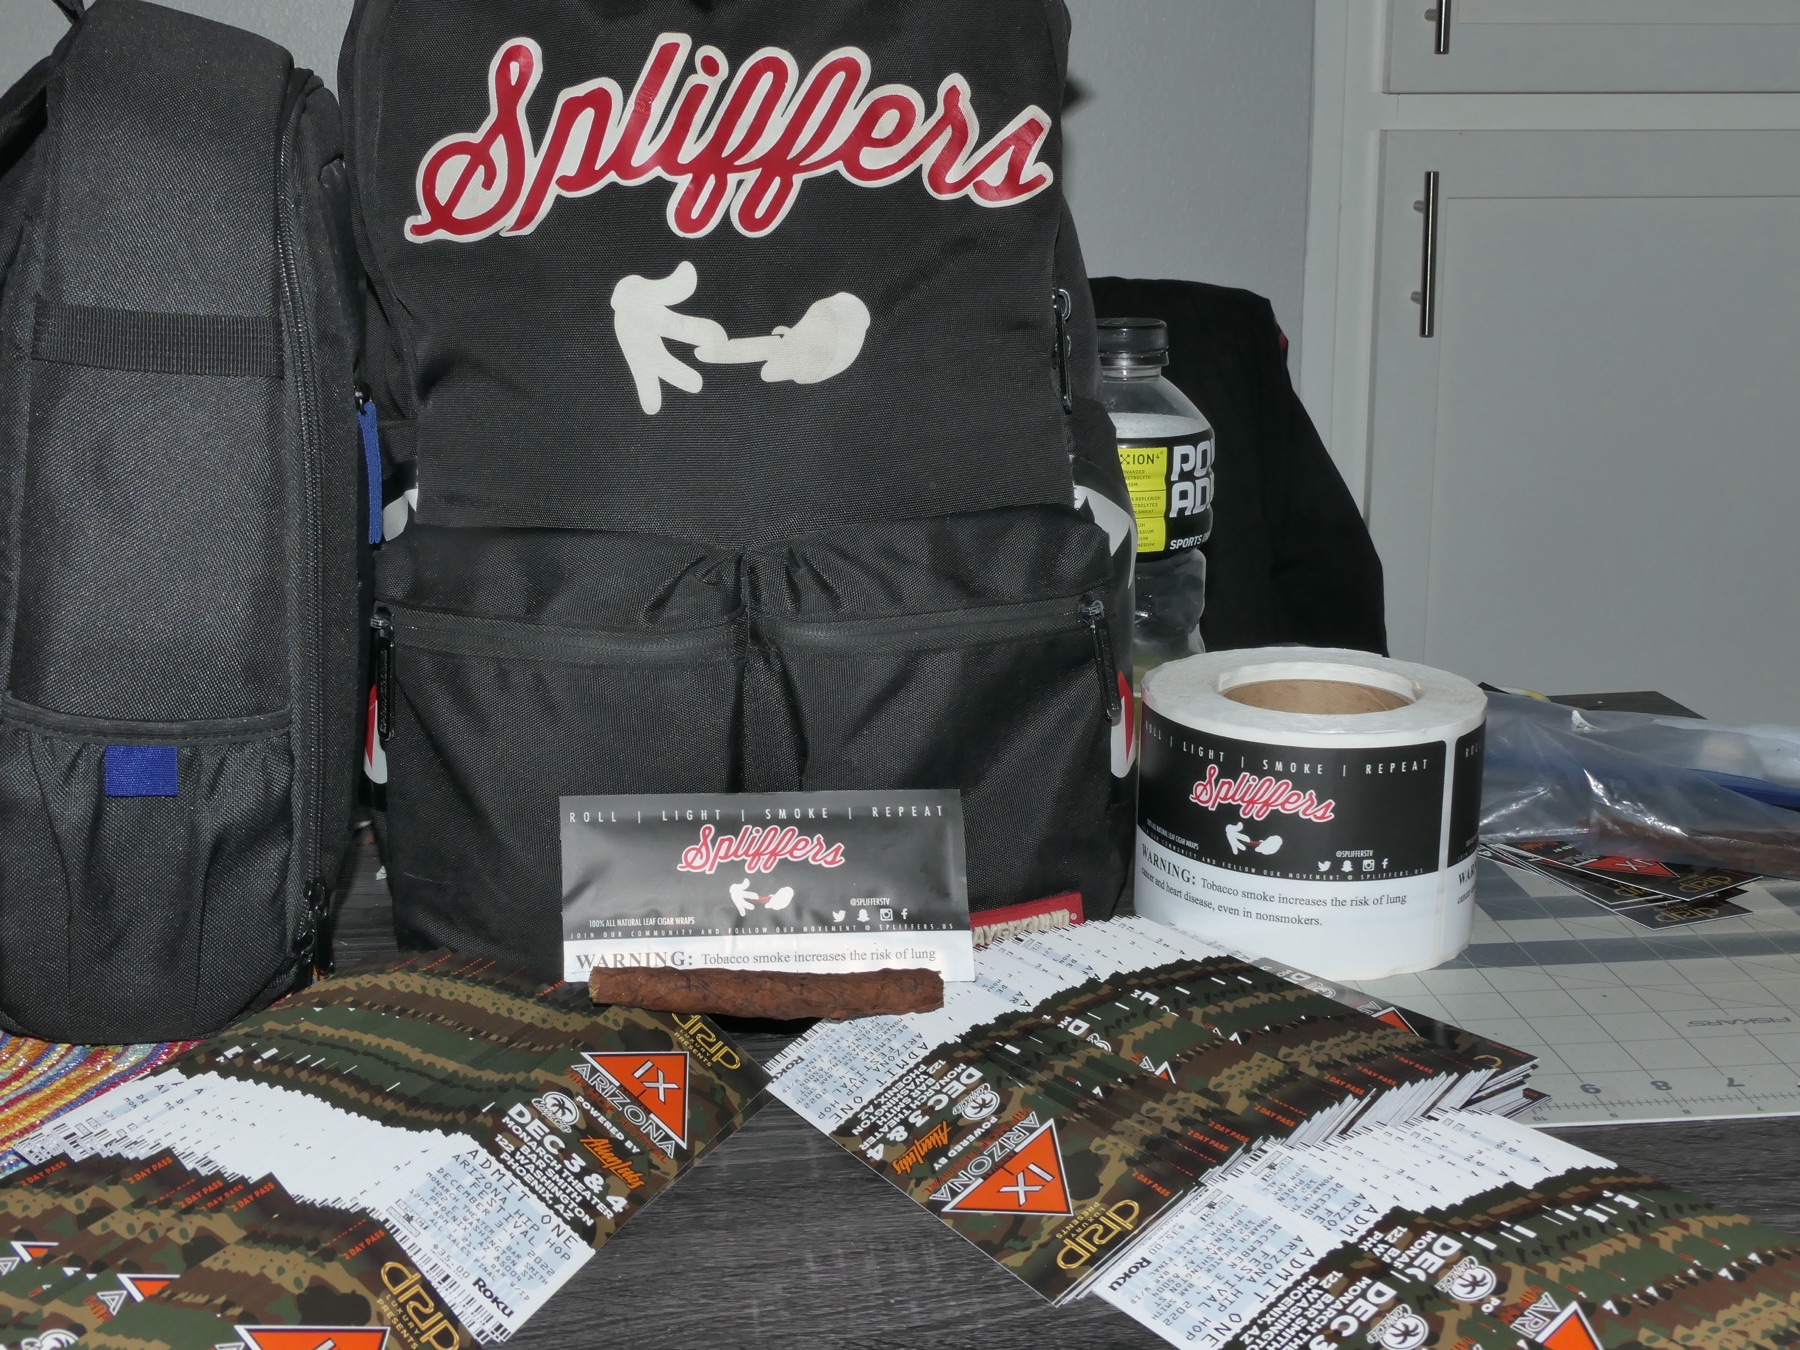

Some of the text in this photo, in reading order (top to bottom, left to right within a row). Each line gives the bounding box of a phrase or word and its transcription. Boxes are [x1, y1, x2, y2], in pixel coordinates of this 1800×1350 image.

[405, 32, 1053, 243] Spliffers
[1170, 439, 1215, 482] PO
[1169, 473, 1214, 518] AD
[1170, 534, 1203, 550] SPORTS
[1183, 741, 1225, 762] LIGHT
[1262, 759, 1323, 775] SMOKE
[1365, 759, 1428, 775] REPEAT
[569, 805, 942, 823] ROLL LIGHT SMOKE REPEAT
[1189, 764, 1335, 823] Spliffers
[677, 823, 845, 874] Spliffers
[1142, 843, 1407, 907] WARNING: Tobacco smoke increases the risk of lung
[1222, 861, 1424, 881] FOLLOW OUR MOVEMENT SPLIFFERS.US
[1336, 850, 1374, 858] @SPLIFFERSTV
[589, 916, 695, 928] 100% ALL NATURAL LEAF CIGAR WRAPS
[850, 897, 890, 906] @SPLIFFERSTV
[973, 908, 1070, 949] AYGROUND
[1154, 876, 1165, 890] and
[1166, 881, 1182, 898] heart
[1183, 891, 1215, 911] disease,
[1217, 903, 1240, 916] even
[1242, 907, 1252, 918] in
[1255, 913, 1323, 926] nonsmokers.
[631, 929, 692, 937] COMMUNITY
[728, 927, 768, 935] FOLLOW
[803, 925, 857, 933] MOVEMENT
[879, 923, 954, 931] SPLIFFERS.US
[576, 947, 936, 969] WARNING: Tobacco smoke increases the risk of lung
[1687, 1016, 1792, 1028] FISKARS
[829, 1041, 928, 1123] ADMIT ONE
[832, 1046, 894, 1093] FESTIVAL
[852, 1059, 946, 1135] 122 WASHINGTON
[857, 1064, 927, 1120] PHOENIX, AZ
[1650, 1080, 1673, 1091] 8
[1726, 1077, 1745, 1088] 7
[570, 1063, 675, 1159] ARIZONA
[575, 1096, 640, 1152] POWERED BY
[859, 1063, 966, 1150] MONARCH THEATER
[866, 1066, 983, 1160] DEC 3 & 4
[876, 1077, 935, 1125] BAR SMITH
[502, 1116, 613, 1219] MONARCH THEATER
[508, 1103, 627, 1212] DEC 3 & 4
[928, 1111, 1039, 1202] ARIZONA
[933, 1116, 997, 1170] POWERED BY
[27, 1169, 45, 1184] DAY
[44, 1160, 67, 1176] PASS
[466, 1149, 578, 1249] ADMIT ONE
[495, 1134, 594, 1226] 122 WASHINGTON
[500, 1152, 574, 1220] PHOENIX, AZ
[520, 1145, 582, 1202] BAR SMITH
[1136, 1173, 1154, 1185] DAY
[1151, 1182, 1171, 1197] PASS
[426, 1172, 548, 1285] MONARCH THEATER BAR SMITH
[436, 1167, 490, 1216] DECEMBER
[527, 1250, 555, 1276] 2022
[452, 1154, 570, 1260] ARIZONA HIP HOP
[469, 1182, 534, 1246] FESTIVAL
[1055, 1201, 1100, 1239] PRESENTS
[1070, 1207, 1106, 1238] LUXURY
[462, 1215, 517, 1266] WASHINGTON
[1163, 1223, 1281, 1326] DECEMBER 2022
[1186, 1235, 1303, 1340] ARIZONA HIP HOP
[1198, 1250, 1269, 1307] FESTIVAL
[1201, 1247, 1314, 1347] ADMIT ONE
[376, 1298, 418, 1350] PRESENTS
[385, 1294, 420, 1335] LUXURY
[1330, 1281, 1397, 1337] DEC
